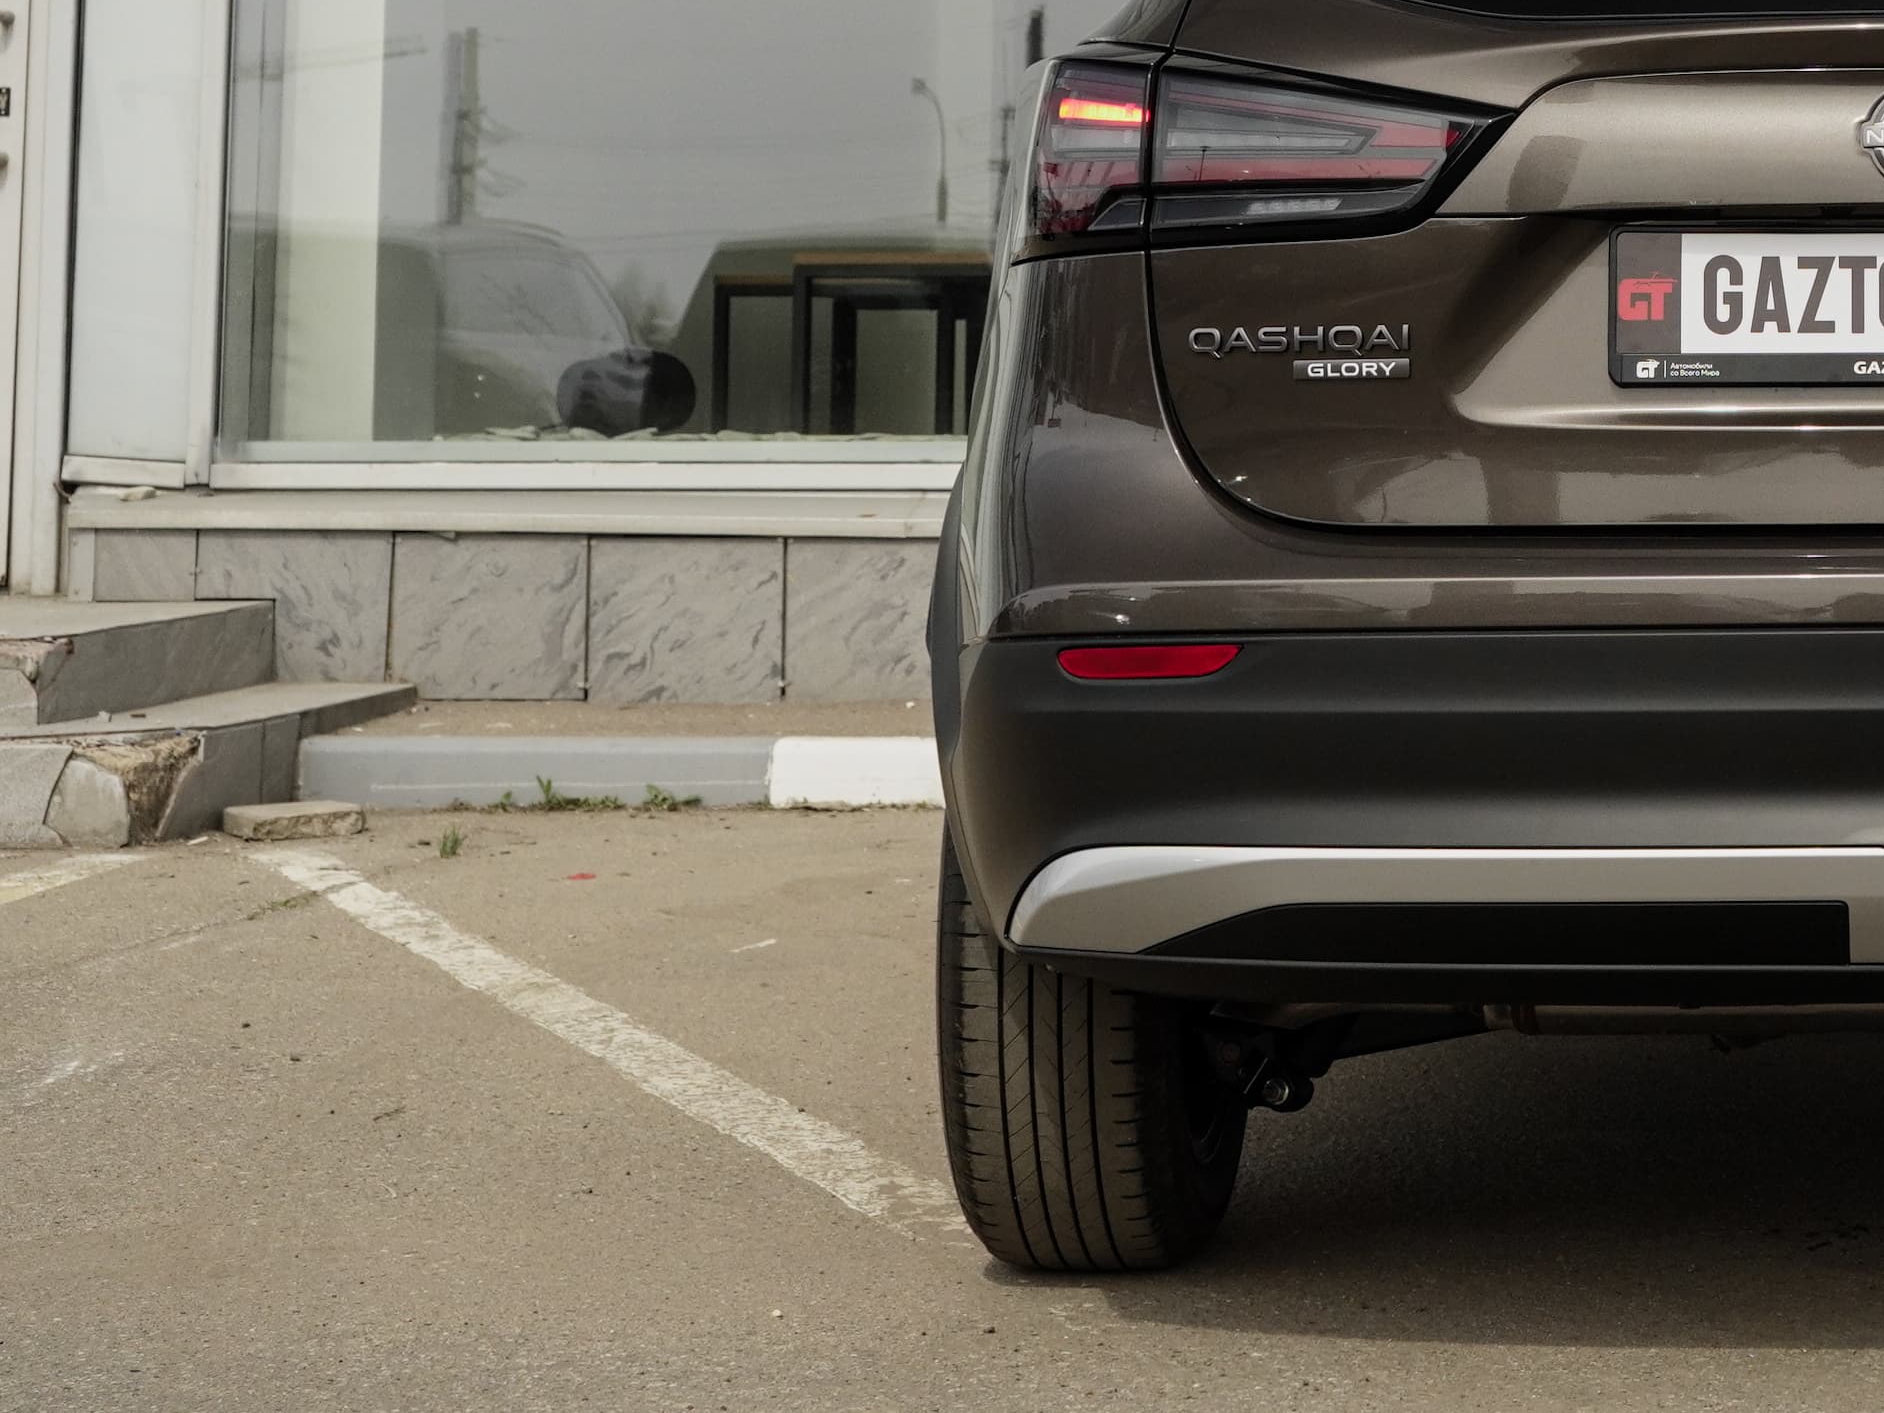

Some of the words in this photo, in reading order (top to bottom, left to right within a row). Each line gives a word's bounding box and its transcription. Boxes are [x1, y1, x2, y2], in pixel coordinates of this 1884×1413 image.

[1617, 270, 1678, 321] GT
[1188, 323, 1410, 358] QASHQAI
[1307, 361, 1397, 378] GLORY
[1636, 359, 1660, 379] GT
[1670, 362, 1713, 370] Автомобили
